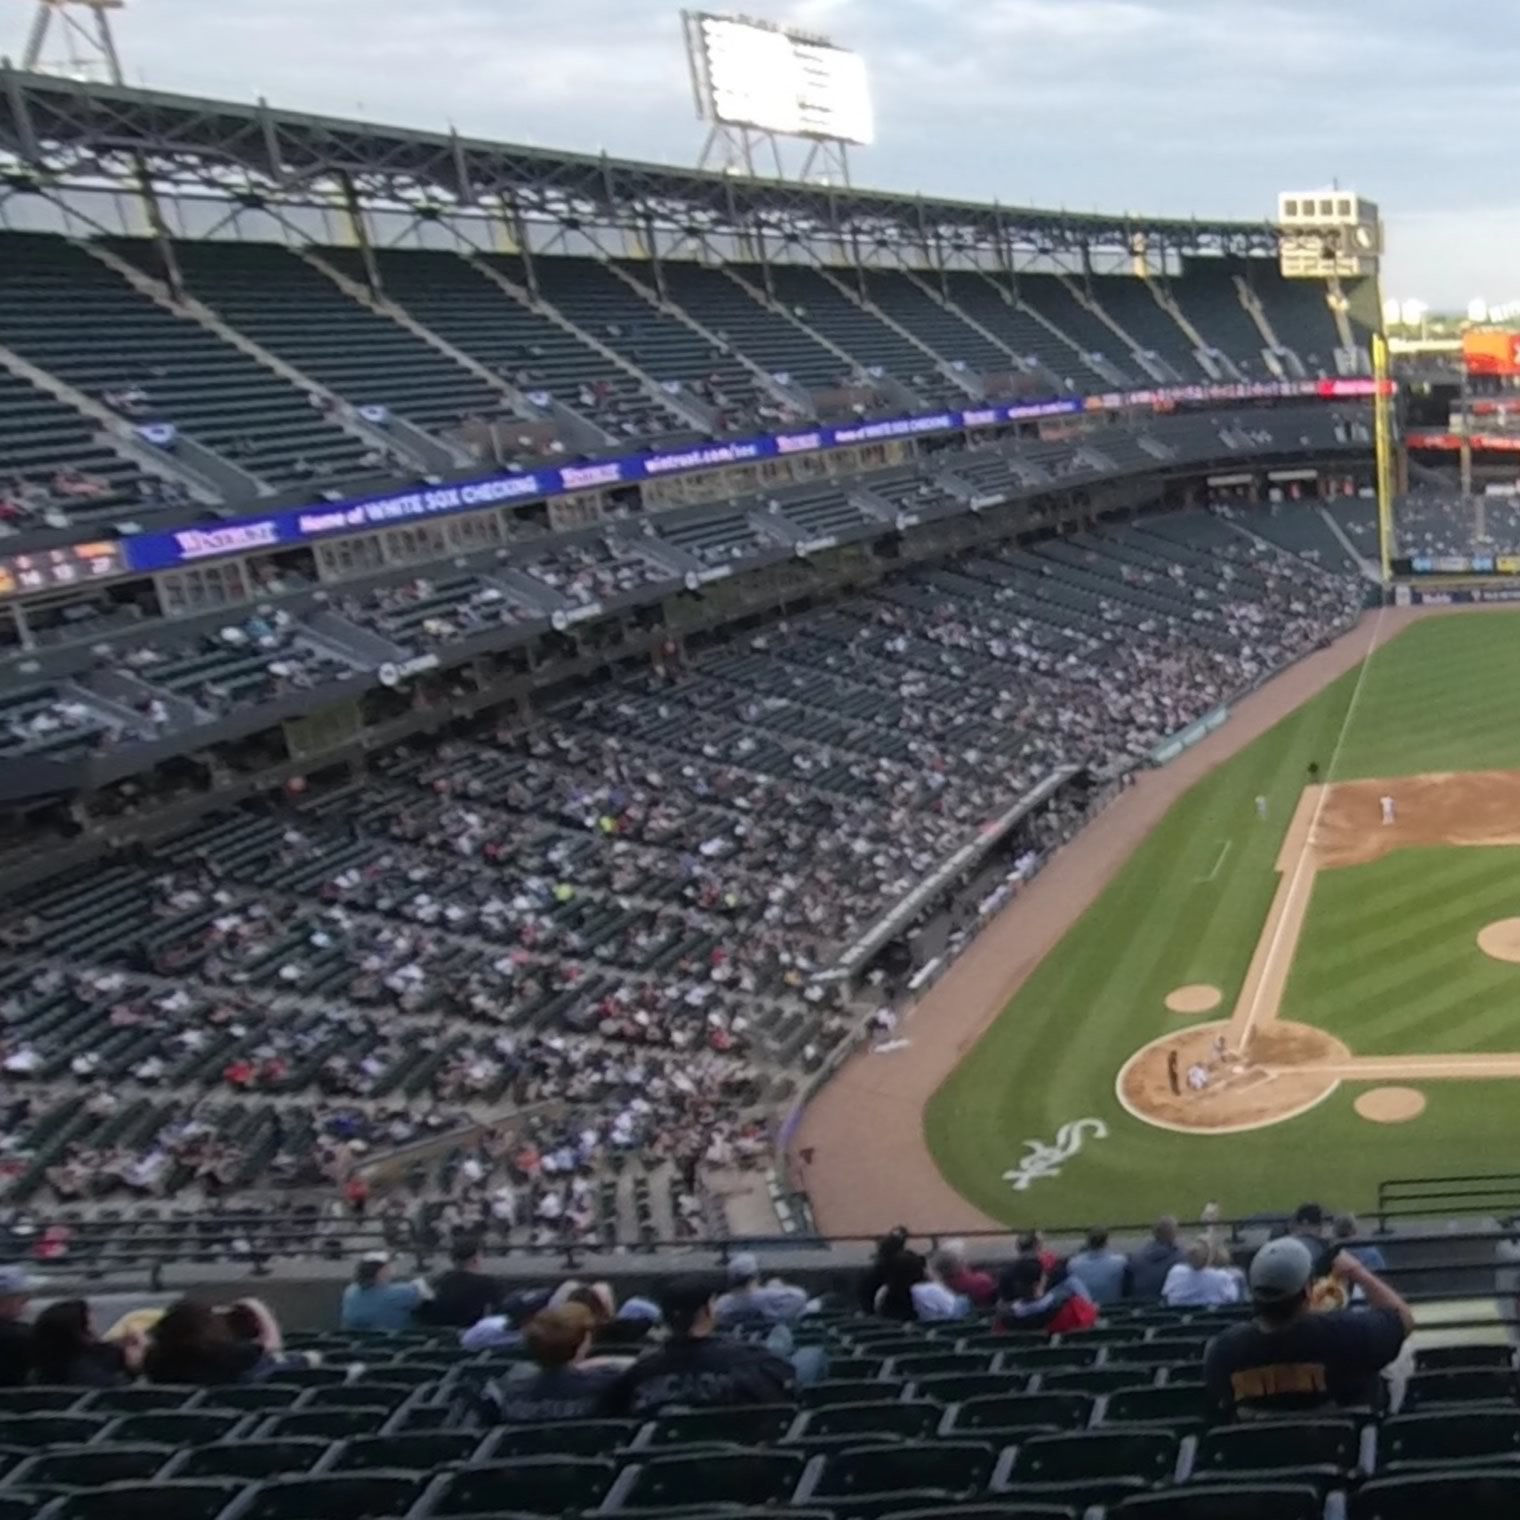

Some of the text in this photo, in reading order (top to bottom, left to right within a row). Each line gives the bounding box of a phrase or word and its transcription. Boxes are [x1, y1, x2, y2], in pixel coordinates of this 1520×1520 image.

[366, 492, 425, 521] WHITE
[425, 486, 460, 511] SOX
[461, 475, 539, 504] CHECKING
